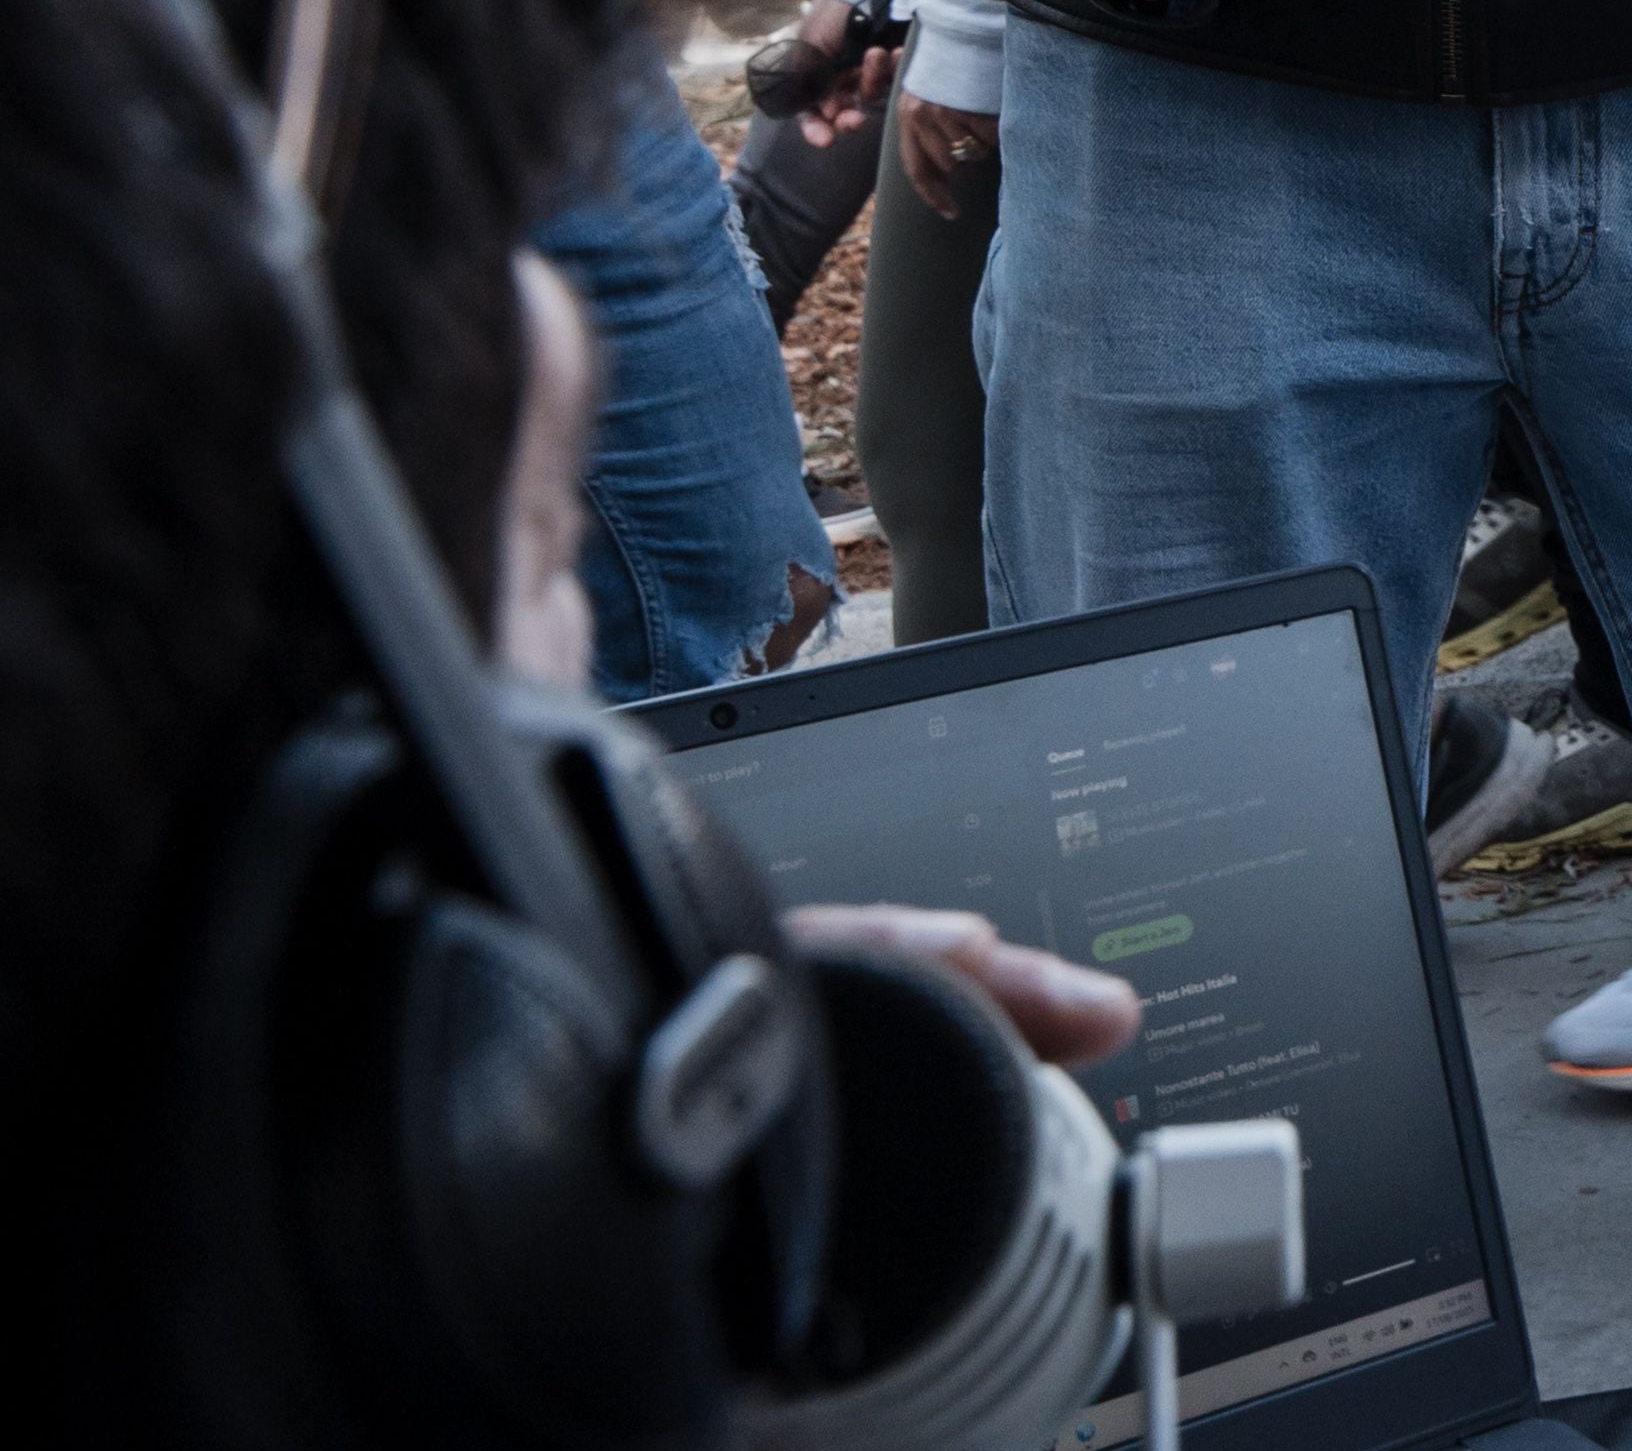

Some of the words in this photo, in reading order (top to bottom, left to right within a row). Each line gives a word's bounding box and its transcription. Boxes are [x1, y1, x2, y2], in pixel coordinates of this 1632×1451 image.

[1046, 744, 1086, 766] Queue
[1155, 986, 1180, 1004] Hot
[1179, 979, 1206, 997] Hits
[1204, 971, 1238, 991] Italia
